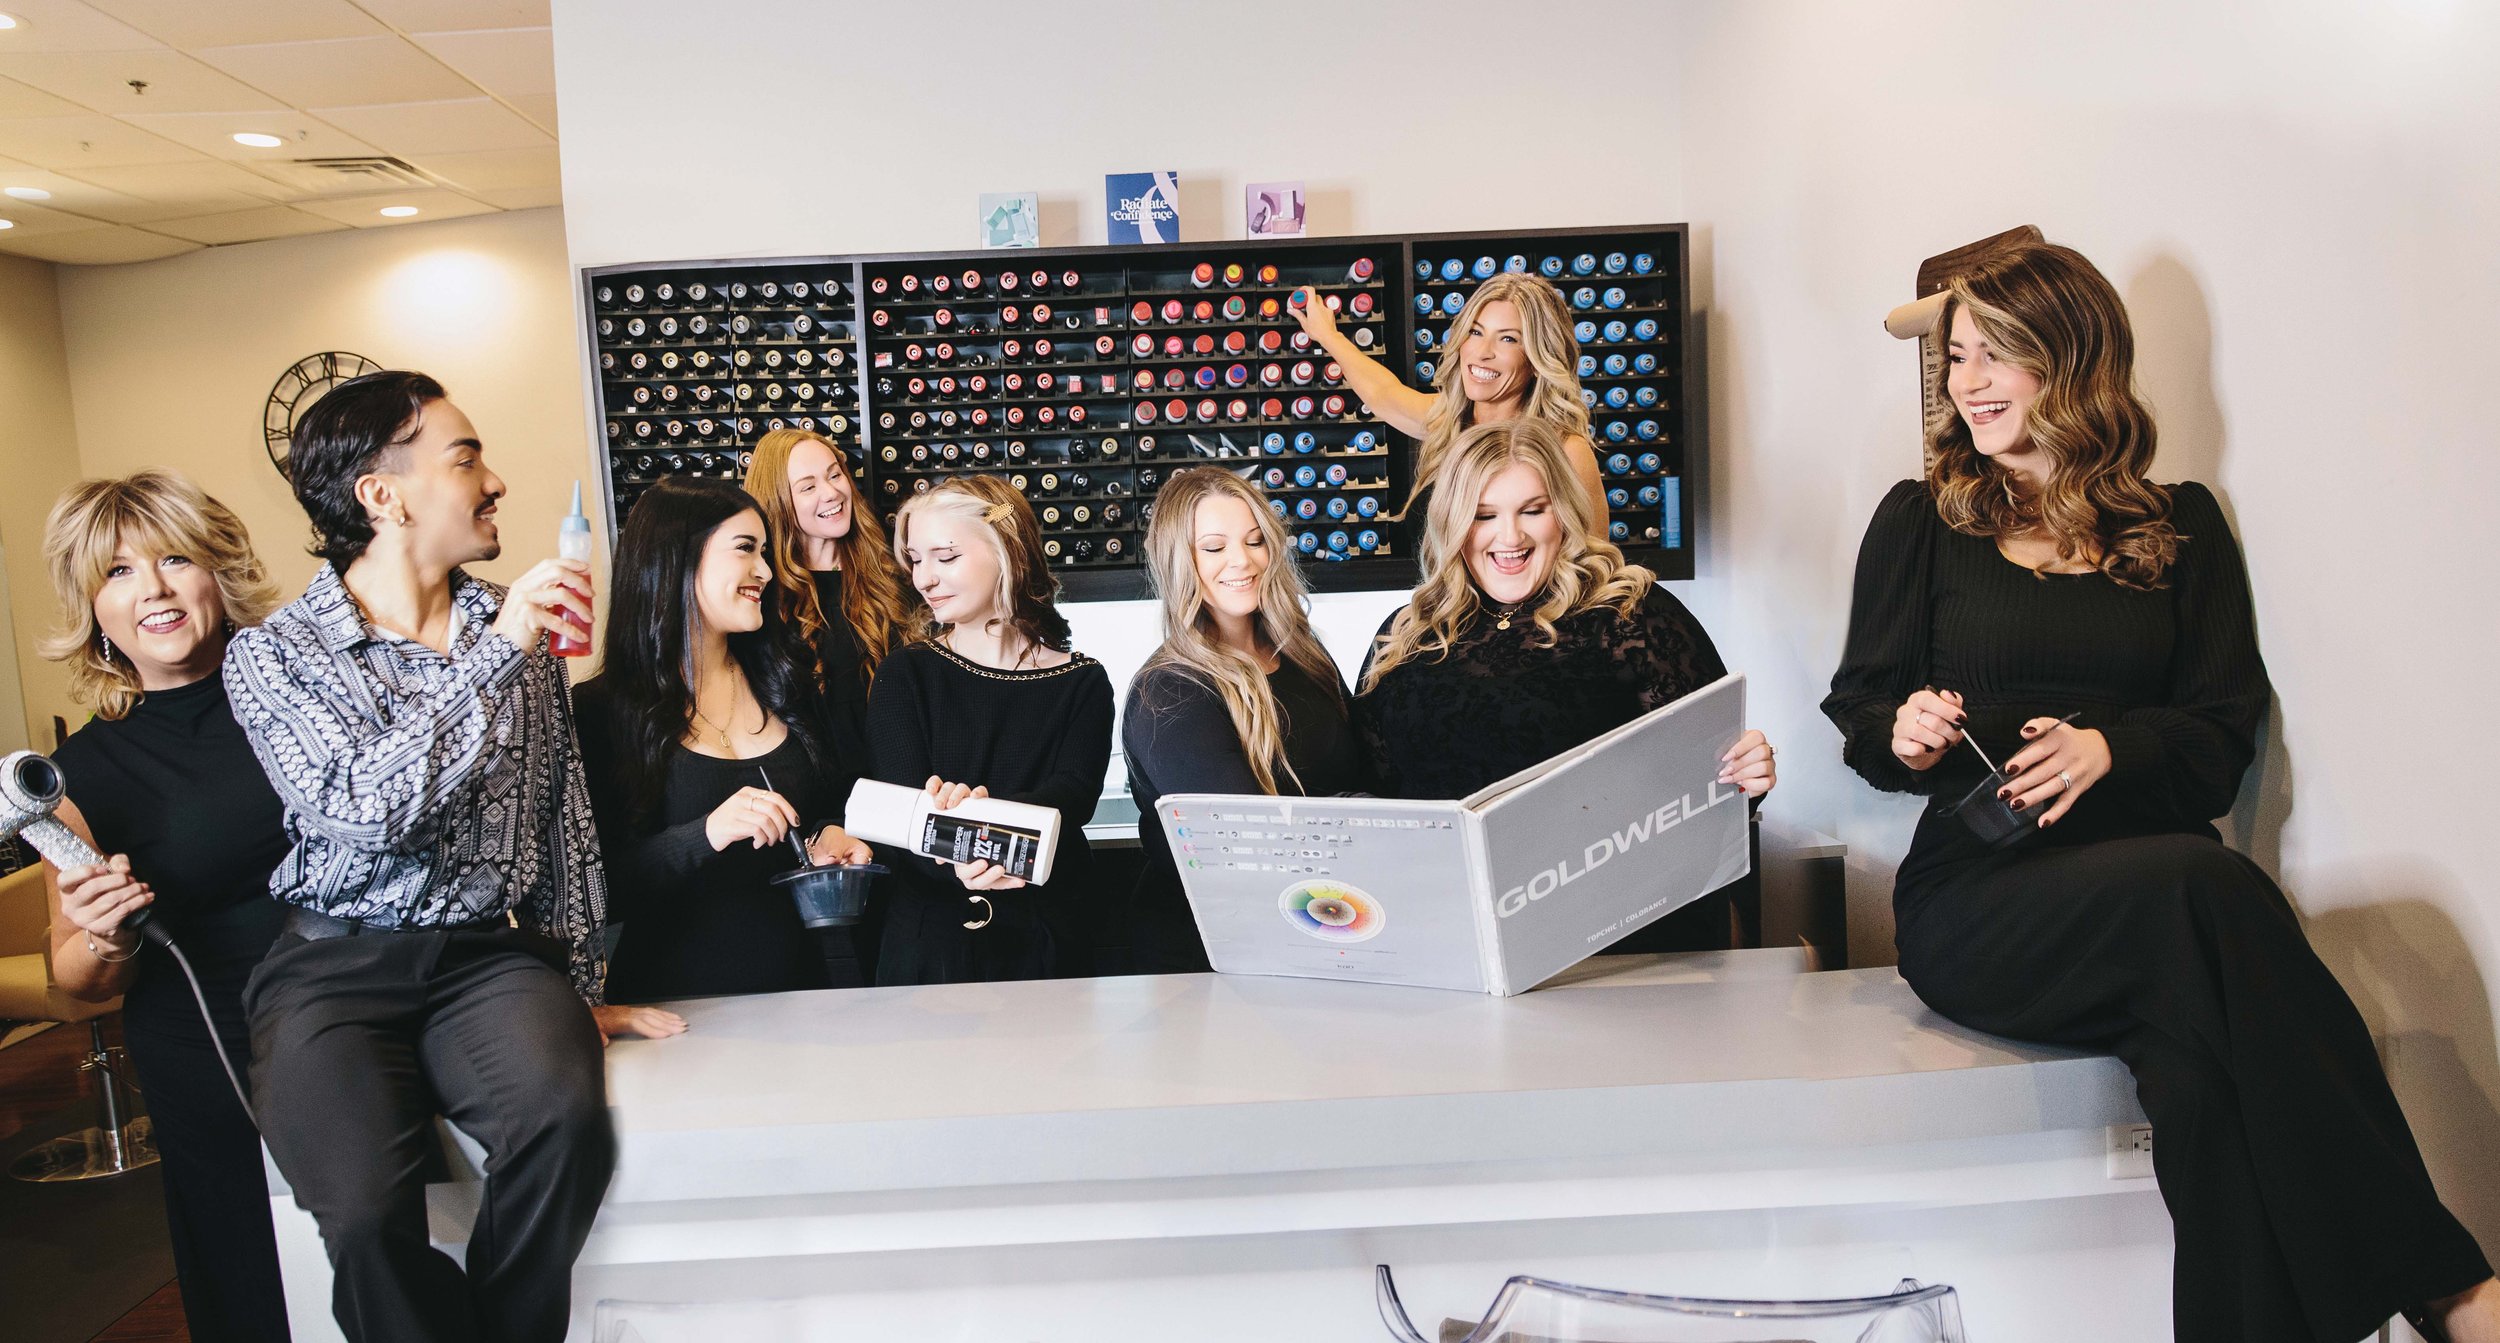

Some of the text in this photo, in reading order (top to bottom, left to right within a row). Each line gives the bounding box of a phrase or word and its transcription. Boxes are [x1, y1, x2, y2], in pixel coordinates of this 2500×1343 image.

[1111, 210, 1173, 221] Confence
[923, 818, 935, 853] GOLDWELL
[952, 825, 964, 861] DEVELOPER
[973, 838, 993, 859] 12%
[1496, 780, 1735, 919] GOLDWELL
[1586, 896, 1668, 943] TOPCHIC COLORANCE
